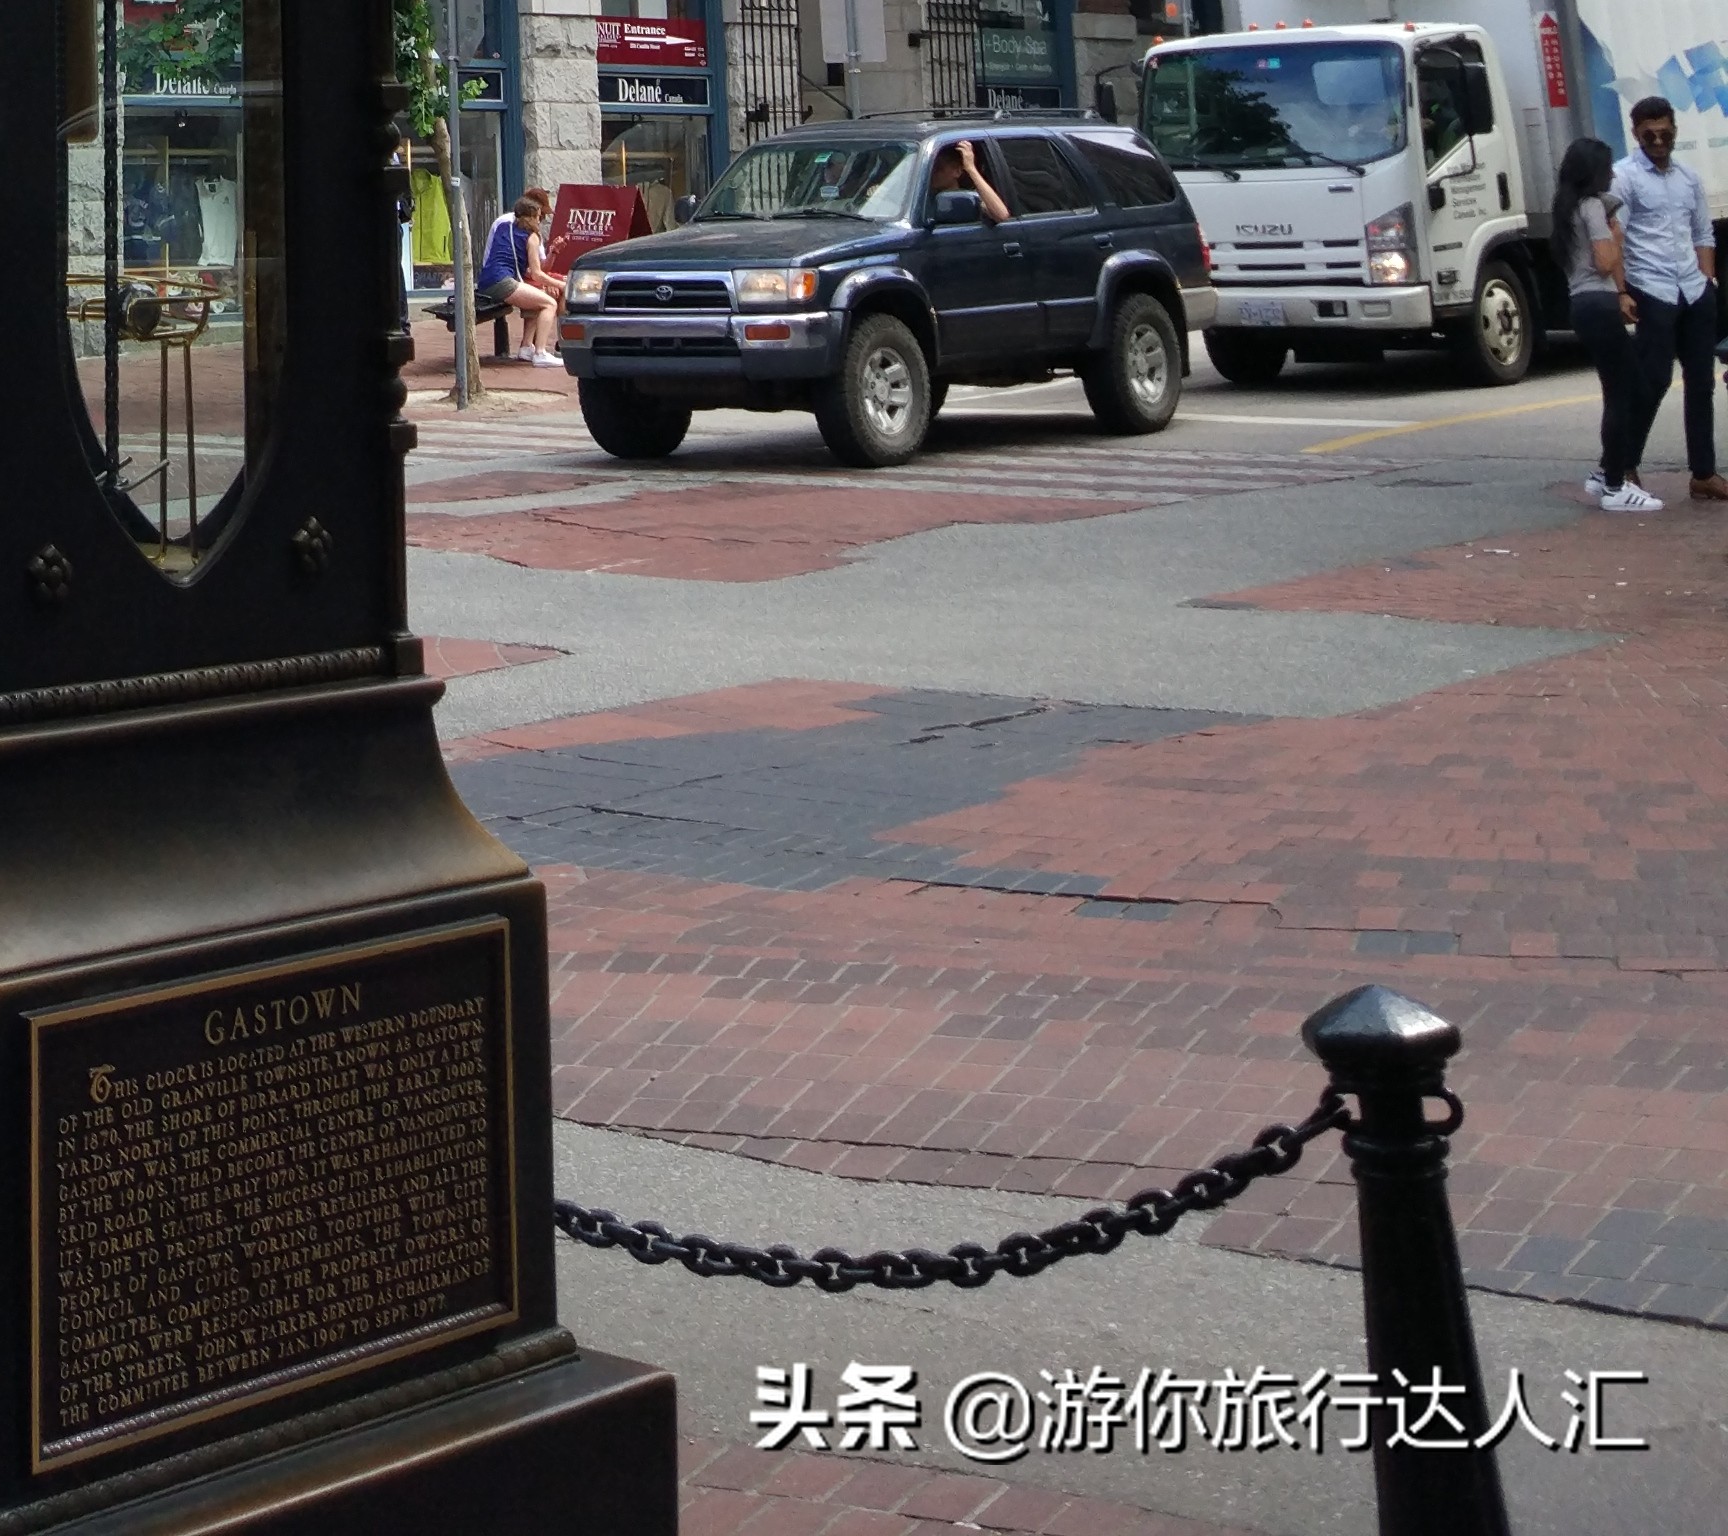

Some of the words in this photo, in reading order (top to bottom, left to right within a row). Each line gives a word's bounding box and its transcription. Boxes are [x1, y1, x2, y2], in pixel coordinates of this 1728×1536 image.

[624, 24, 666, 35] Entrance
[618, 78, 662, 102] Delané
[988, 88, 1023, 110] Delané
[568, 209, 616, 226] INUIT
[1235, 224, 1293, 236] ISUZU
[203, 979, 362, 1047] GASTOWN
[145, 1063, 197, 1091] CLOCK
[199, 1059, 213, 1079] IS
[218, 1043, 284, 1074] LOCATED
[289, 1037, 305, 1057] AT
[309, 1029, 335, 1053] THE
[340, 1013, 405, 1045] WESTERN
[409, 995, 485, 1029] BOUNDARY
